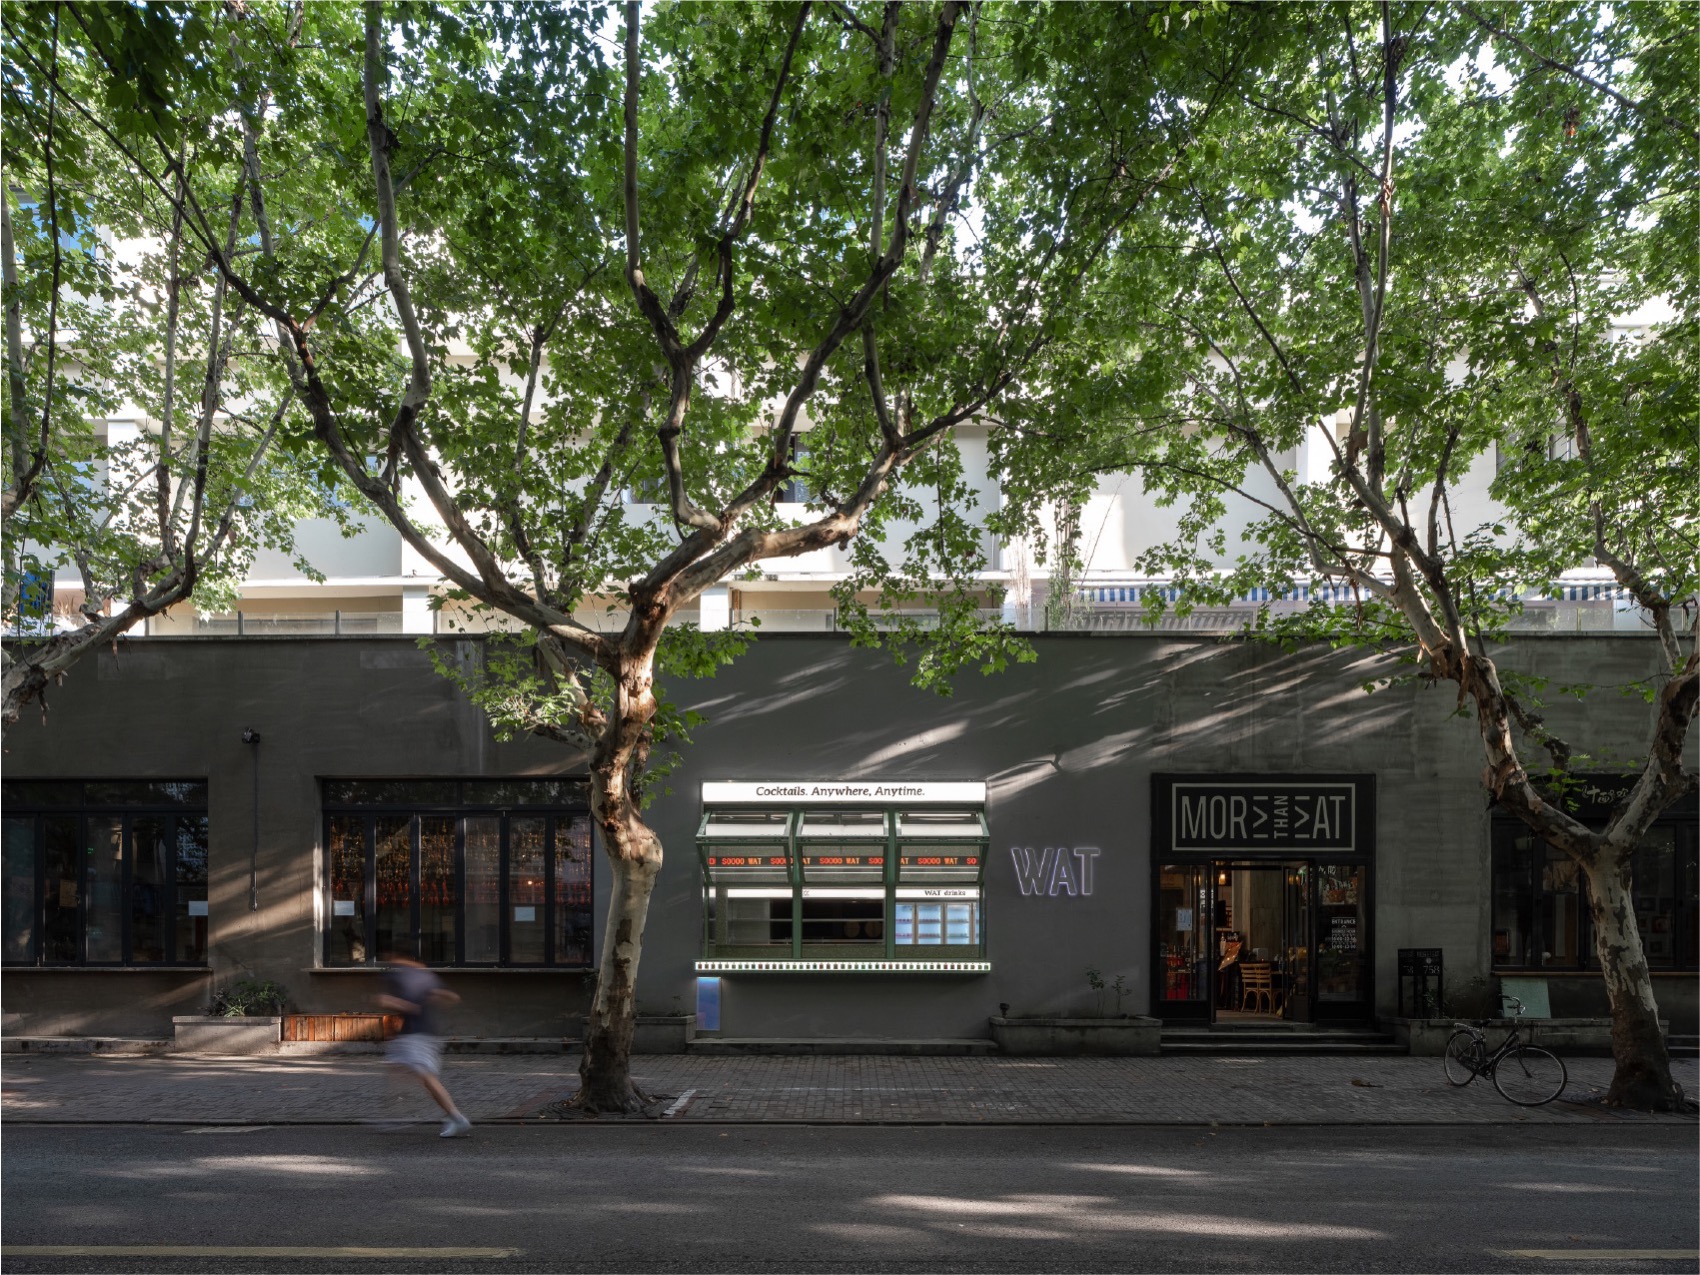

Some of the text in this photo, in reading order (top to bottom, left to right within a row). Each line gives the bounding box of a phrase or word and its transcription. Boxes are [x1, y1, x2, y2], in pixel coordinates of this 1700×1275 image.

[755, 785, 925, 798] Cocktails. Anywhere, Anytime.
[1273, 795, 1288, 839] THAN
[748, 857, 762, 865] WAT
[846, 857, 860, 865] WAT
[944, 857, 958, 865] WAT
[1010, 847, 1100, 896] WAT
